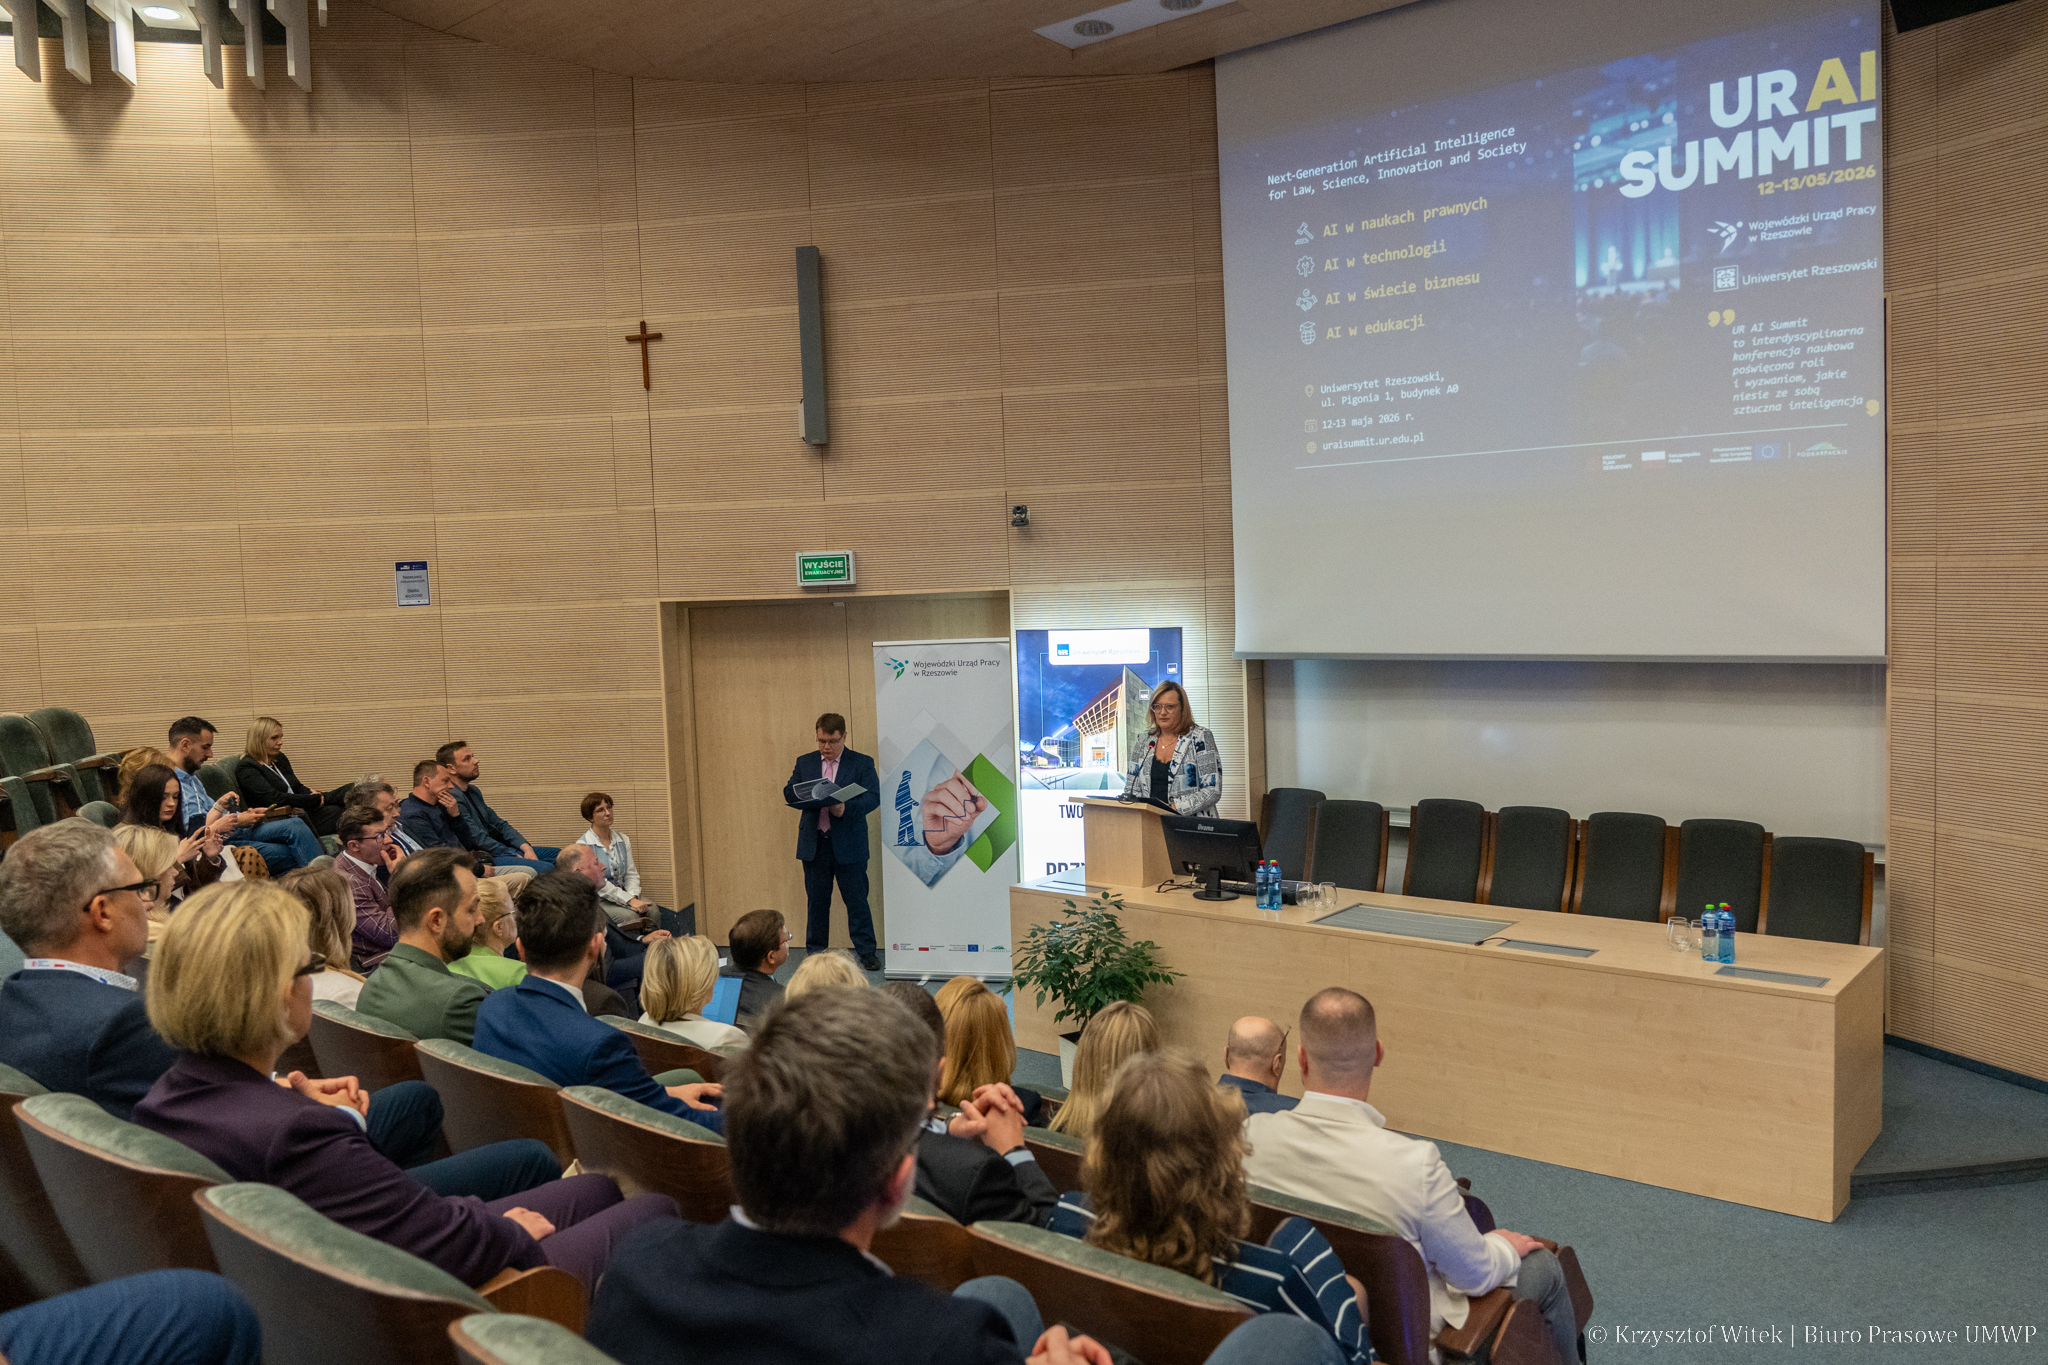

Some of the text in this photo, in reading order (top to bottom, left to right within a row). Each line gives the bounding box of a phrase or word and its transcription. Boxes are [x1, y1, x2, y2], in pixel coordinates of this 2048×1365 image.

[1709, 50, 1876, 128] UR AI
[1267, 126, 1516, 186] Next-Generation Artificial Intelligence
[1619, 107, 1876, 198] SUMMIT
[1268, 140, 1528, 201] for Law, Science, Innovation and Society
[1757, 164, 1877, 196] 12-13/05/2026
[1323, 197, 1488, 238] AI w naukach prawnych
[1749, 203, 1877, 231] Wojewódzki Urząd Pracy
[1749, 225, 1813, 243] w Rzeszowie
[1324, 239, 1447, 272] AI w technologii
[1742, 258, 1878, 286] Uniwersytet Rzeszowski
[1325, 272, 1480, 306] AI w świecie biznesu
[1326, 314, 1425, 340] AI w edukacji
[1732, 317, 1808, 335] UR AI Summit
[1732, 326, 1864, 349] to interdyscyplinarna
[1732, 341, 1854, 362] konferencja naukowa
[1732, 356, 1825, 377] poświęcona roli
[1320, 371, 1446, 395] Uniwersytet Rzeszowski,
[1734, 369, 1847, 388] i wyzwaniom, jakie
[1321, 398, 1335, 408] ul.
[1341, 392, 1380, 407] Pigonia
[1385, 392, 1394, 402] 1,
[1401, 386, 1441, 399] budynek
[1732, 386, 1820, 402] niesie ze sobą
[1733, 395, 1864, 415] sztuczna inteligencja
[1322, 418, 1346, 430] 12-13
[1351, 416, 1373, 428] maja
[1378, 412, 1400, 424] 2026
[1405, 413, 1415, 422] r.
[1322, 431, 1425, 451] uraisummit.ur.edu.pl
[1797, 448, 1848, 458] PODKARPACKIE
[804, 560, 843, 569] WYJŚCIE
[913, 659, 1000, 669] Wojewódzki Urząd Pracy
[922, 669, 958, 677] Rzeszowie
